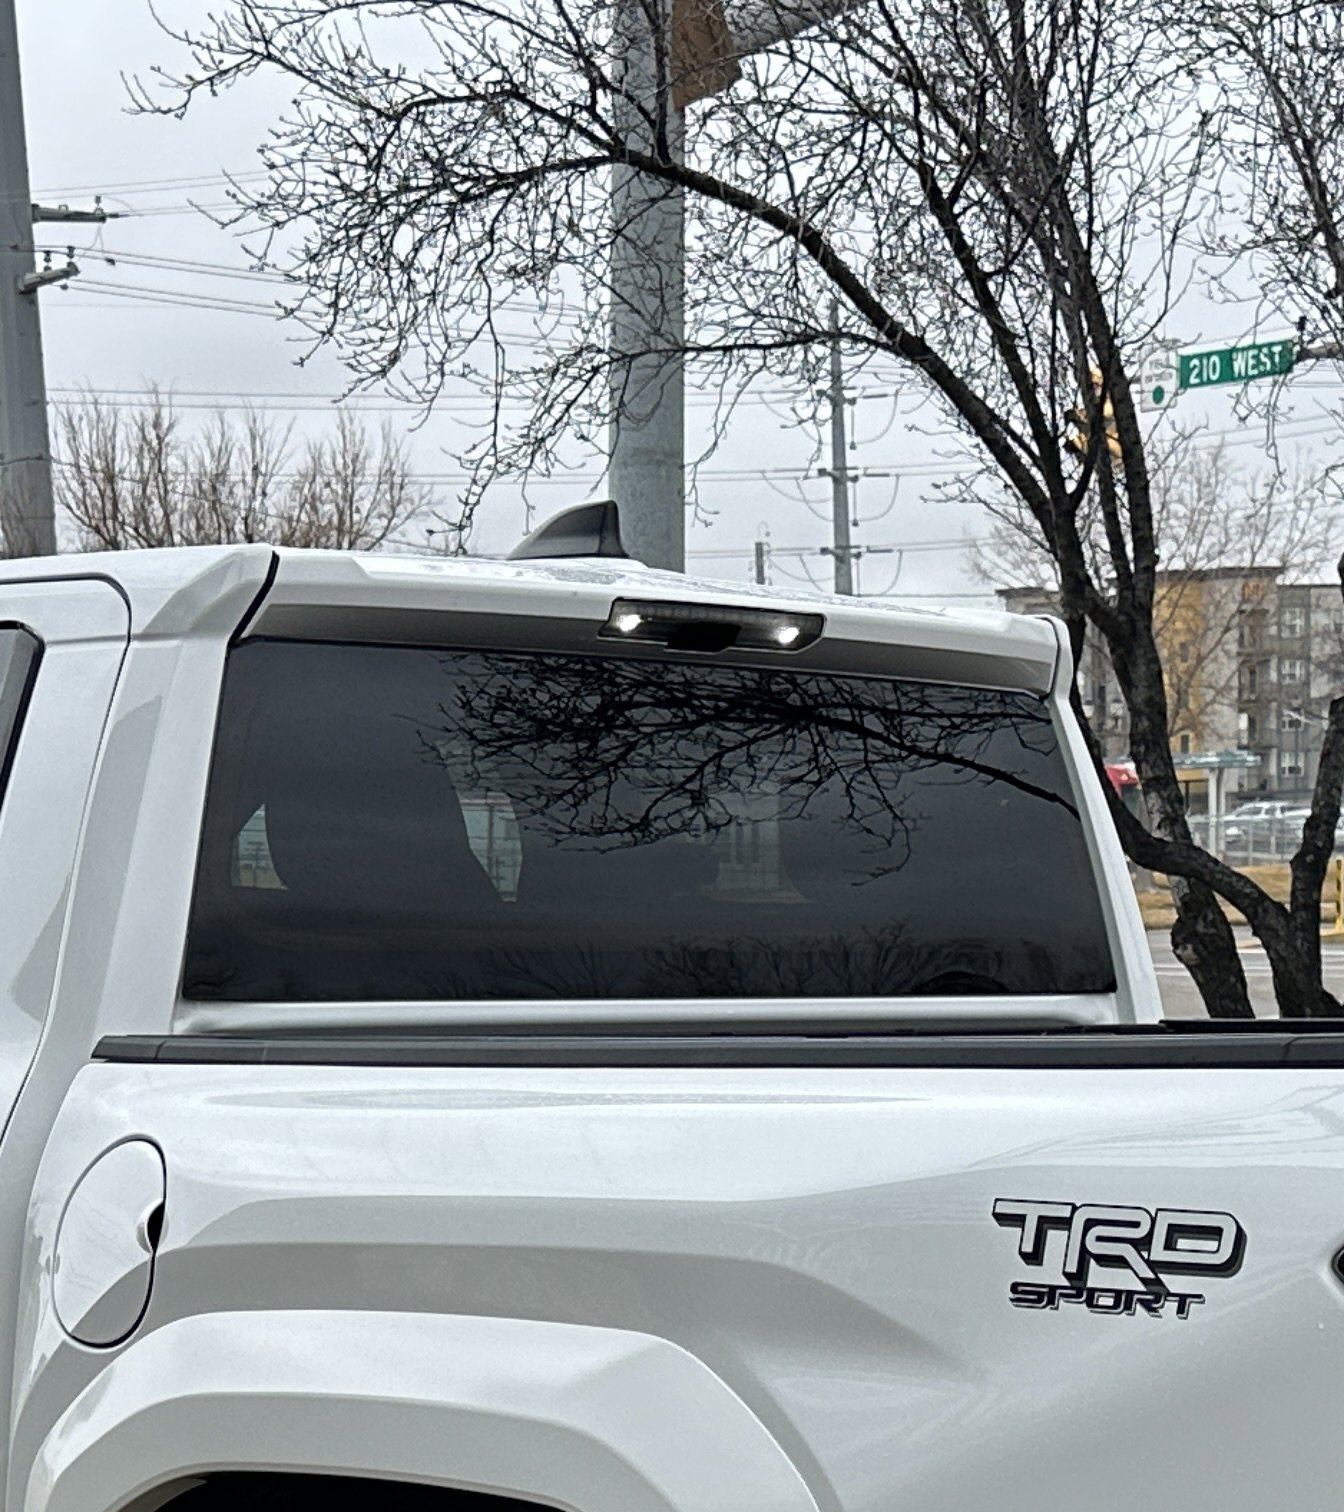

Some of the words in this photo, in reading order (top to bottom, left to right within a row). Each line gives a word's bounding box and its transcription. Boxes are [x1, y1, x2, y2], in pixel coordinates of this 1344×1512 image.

[1188, 354, 1221, 385] 210
[1231, 345, 1283, 379] WEST
[992, 1197, 1248, 1293] TRD
[1009, 1281, 1205, 1320] SPORT
